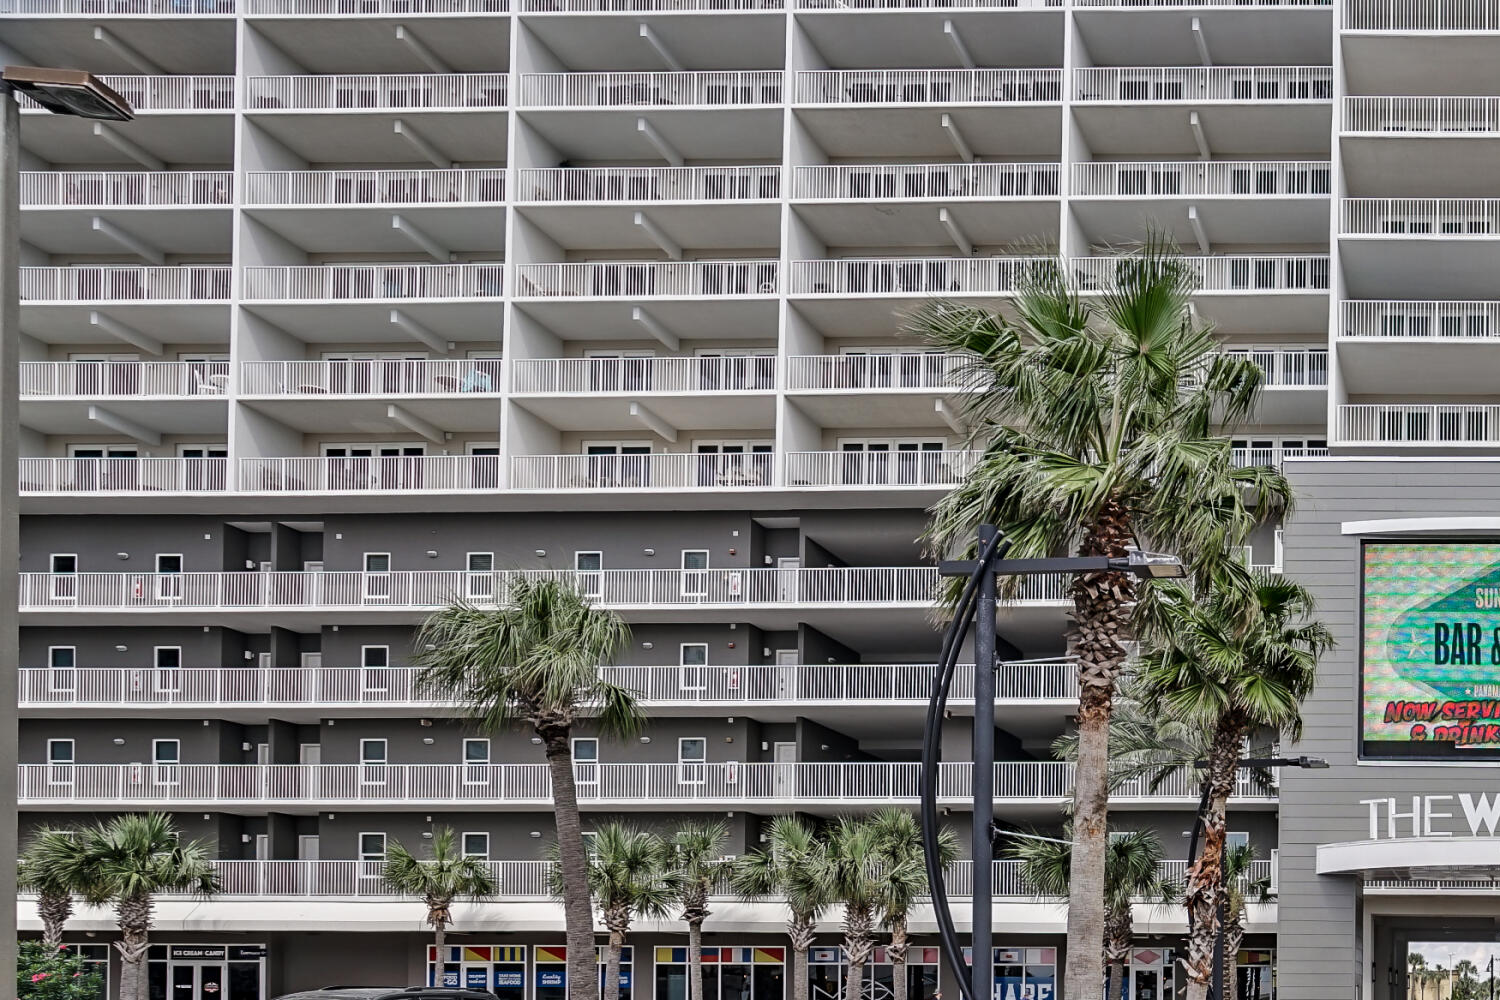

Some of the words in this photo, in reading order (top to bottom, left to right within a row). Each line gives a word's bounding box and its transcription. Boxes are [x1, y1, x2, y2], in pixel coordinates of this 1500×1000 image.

[1434, 621, 1482, 666] BAR
[1384, 700, 1437, 724] NOW
[1359, 794, 1453, 840] THE
